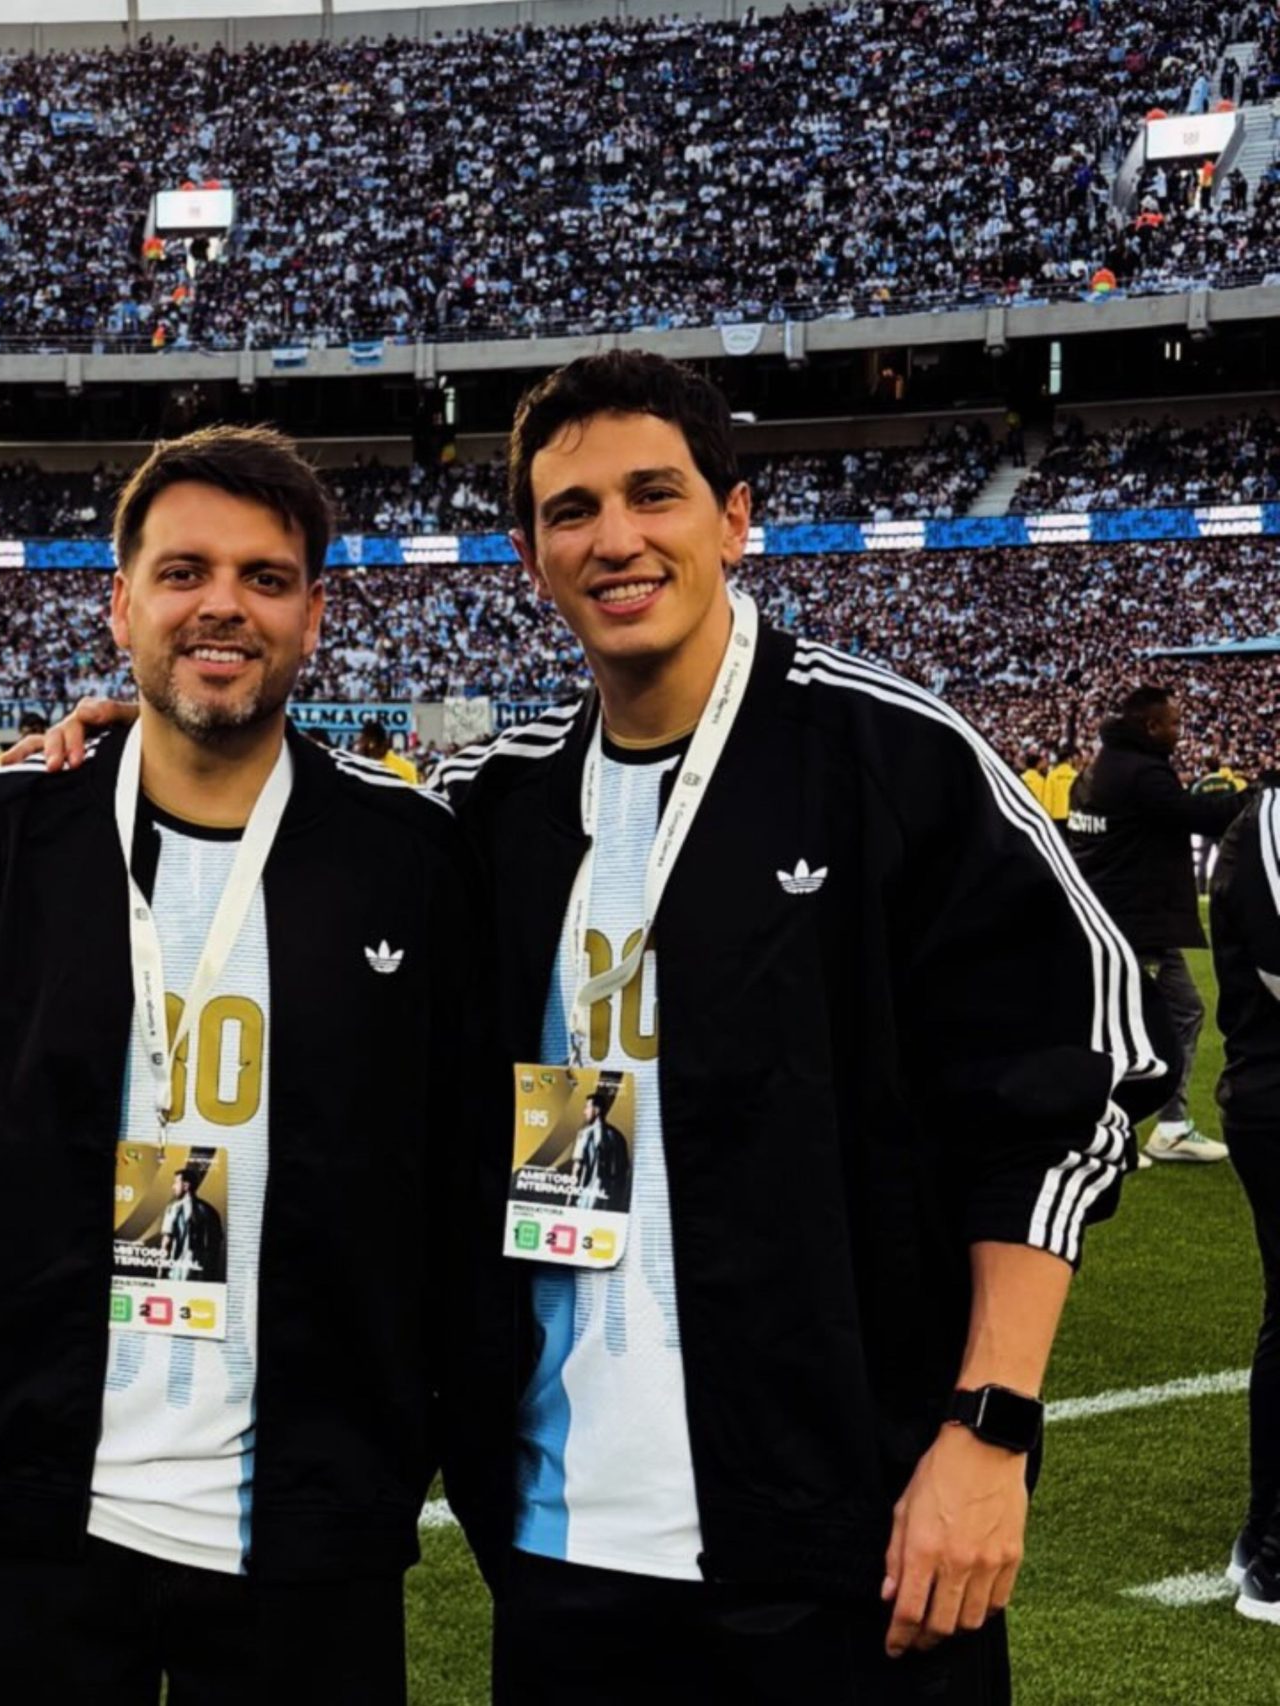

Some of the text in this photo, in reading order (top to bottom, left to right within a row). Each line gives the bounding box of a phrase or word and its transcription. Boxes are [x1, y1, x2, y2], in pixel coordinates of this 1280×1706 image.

[289, 707, 408, 727] ALMAGRO
[545, 1232, 557, 1246] 2
[581, 1236, 594, 1250] 3
[139, 1303, 151, 1317] 2
[179, 1306, 192, 1320] 3
